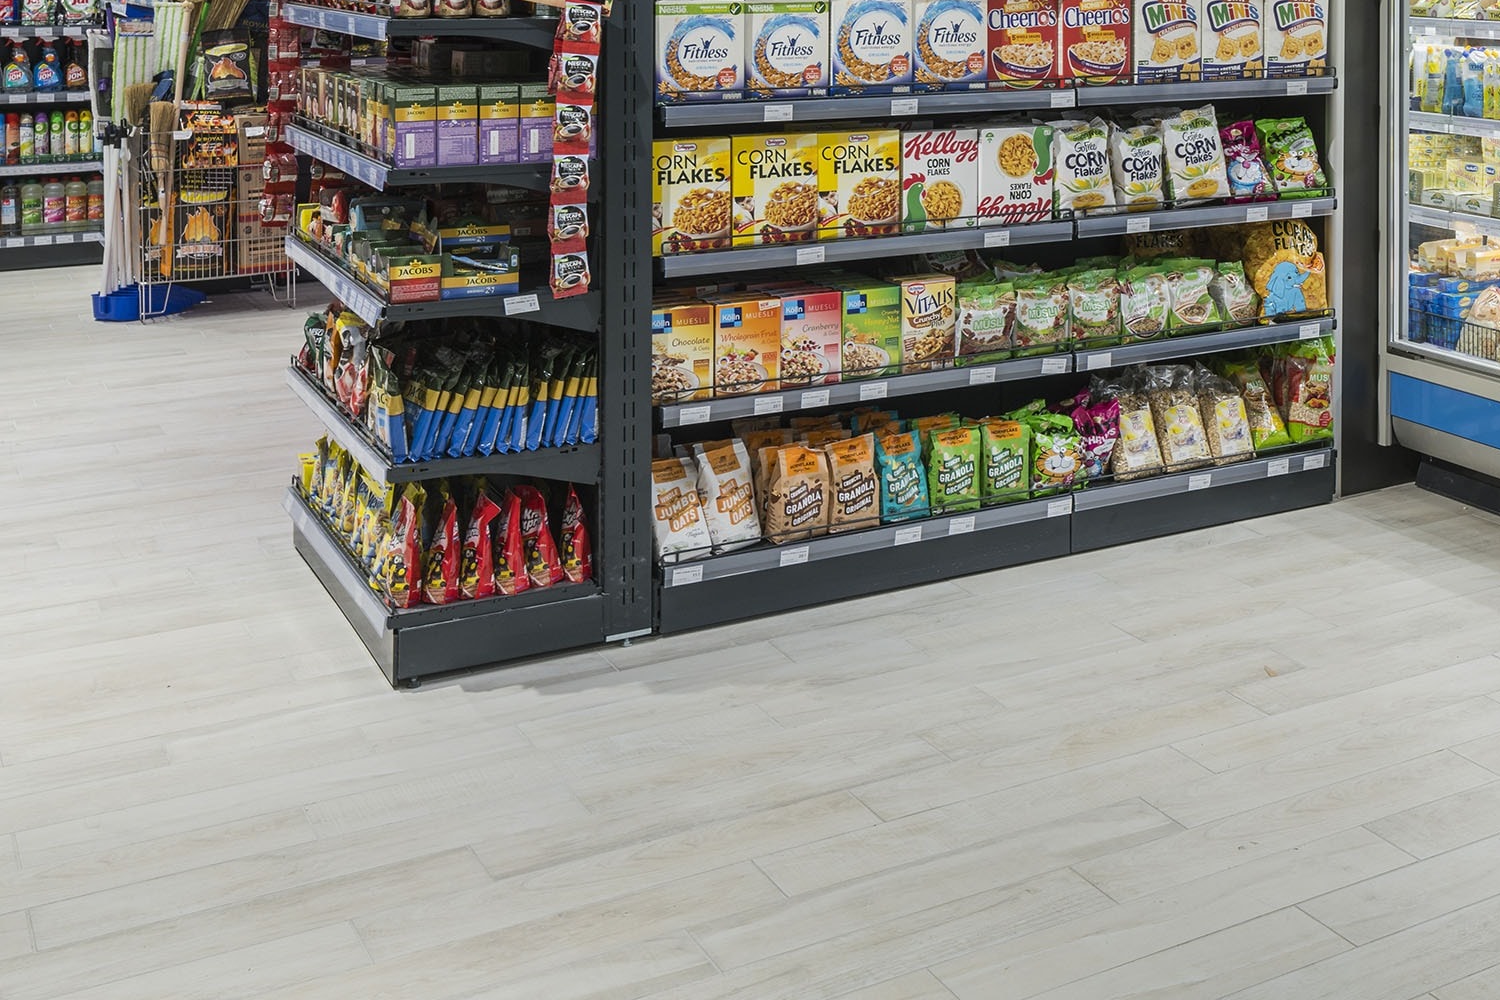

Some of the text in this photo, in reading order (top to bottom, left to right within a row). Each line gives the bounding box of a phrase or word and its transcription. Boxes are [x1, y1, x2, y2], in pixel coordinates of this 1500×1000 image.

[988, 8, 1056, 30] Cheerios
[1064, 7, 1129, 29] Cheerios
[855, 30, 901, 48] Fitness
[932, 29, 977, 44] Fitness
[684, 44, 728, 59] Fitness
[821, 145, 869, 161] CORN
[1175, 136, 1217, 159] CORN
[737, 149, 787, 166] CORN
[833, 157, 895, 174] FLAKES
[927, 158, 950, 168] CORN
[1065, 152, 1107, 169] CORN
[1122, 155, 1161, 172] CORN
[657, 167, 725, 185] FLAKES
[749, 162, 813, 179] FLAKES
[927, 168, 950, 176] FLAKES
[457, 227, 488, 236] JACOBS
[398, 265, 433, 277] JACOBS
[466, 276, 497, 285] JACOBS
[676, 317, 706, 326] MUESLI
[745, 311, 774, 320] MUESLI
[802, 322, 839, 333] Cranberry
[671, 336, 710, 347] Chocolate
[939, 462, 974, 483] GRANOLA
[988, 458, 1023, 477] GRANOLA
[945, 477, 972, 495] ORCHARD
[995, 469, 1020, 488] ORCHARD
[720, 486, 750, 512] JUMBO
[838, 480, 875, 502] GRANOLA
[660, 493, 696, 521] JUMBO
[786, 490, 821, 515] GRANOLA
[673, 510, 698, 531] OATS
[792, 506, 819, 527] ORIGINAL
